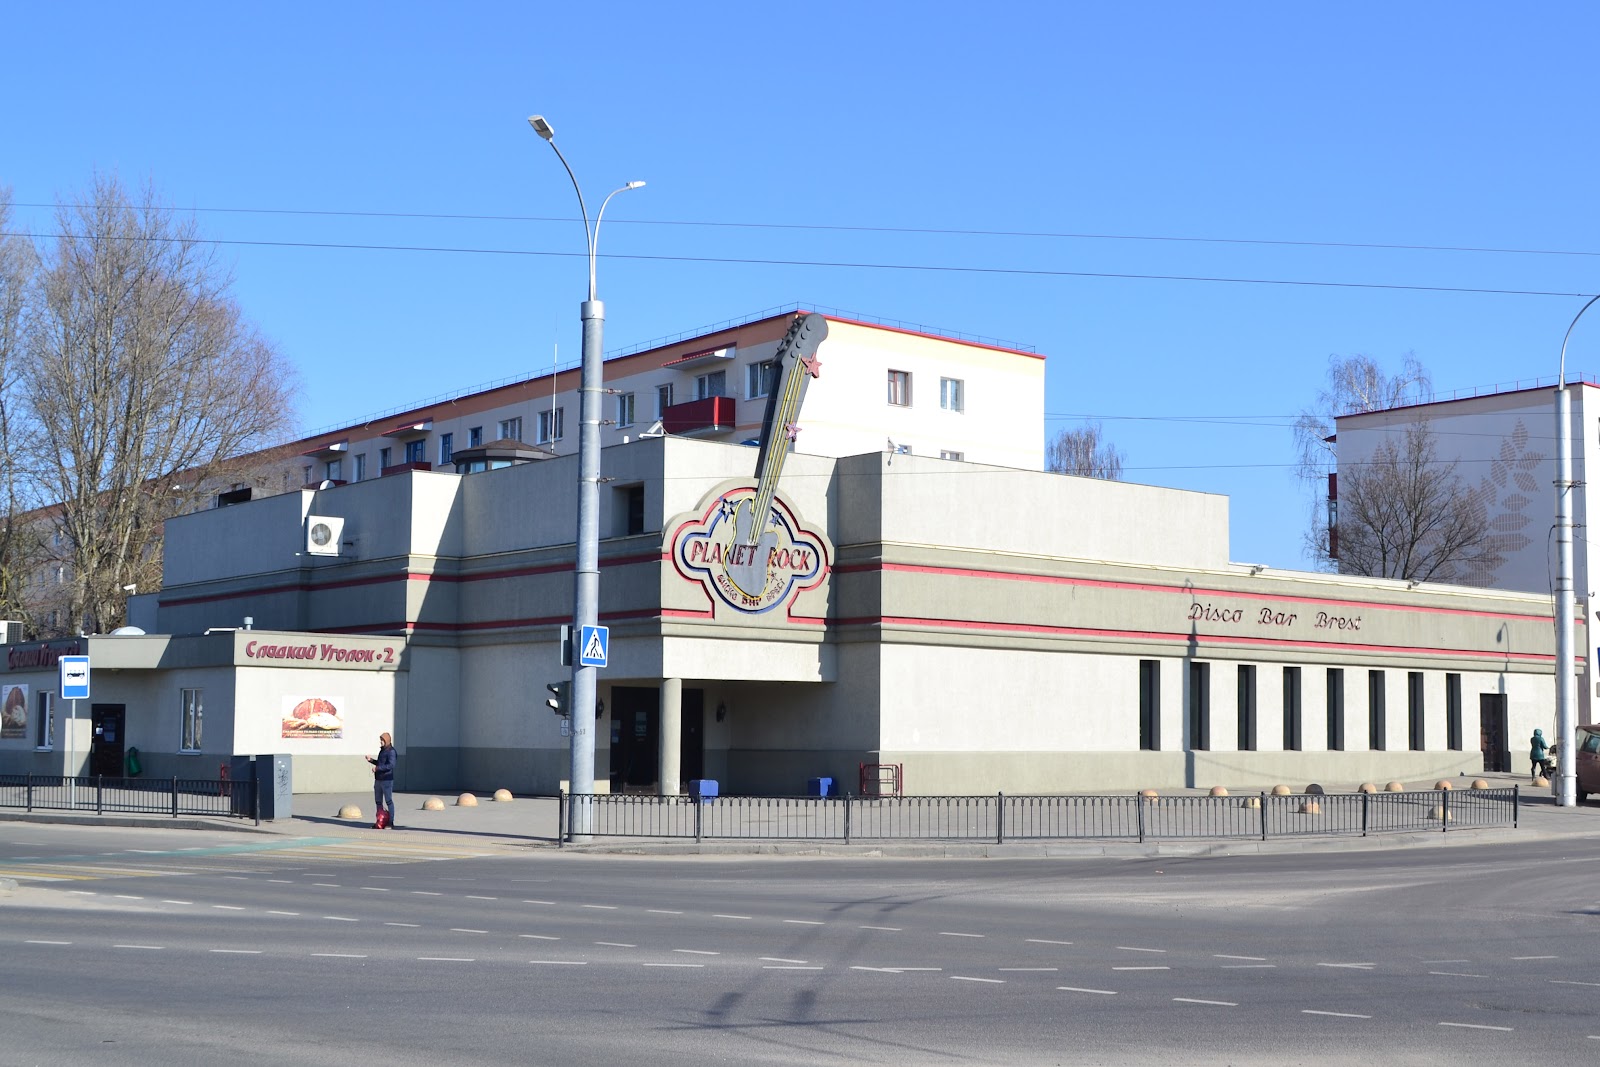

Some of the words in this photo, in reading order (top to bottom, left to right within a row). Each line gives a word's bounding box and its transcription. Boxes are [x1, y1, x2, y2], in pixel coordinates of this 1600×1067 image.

[690, 540, 758, 566] PLANET
[767, 546, 811, 571] ROCK
[1188, 602, 1243, 623] Disco
[1258, 607, 1297, 627] Bar
[1314, 611, 1362, 631] Brest
[246, 640, 318, 660] Сладкий
[320, 643, 375, 663] Уголок
